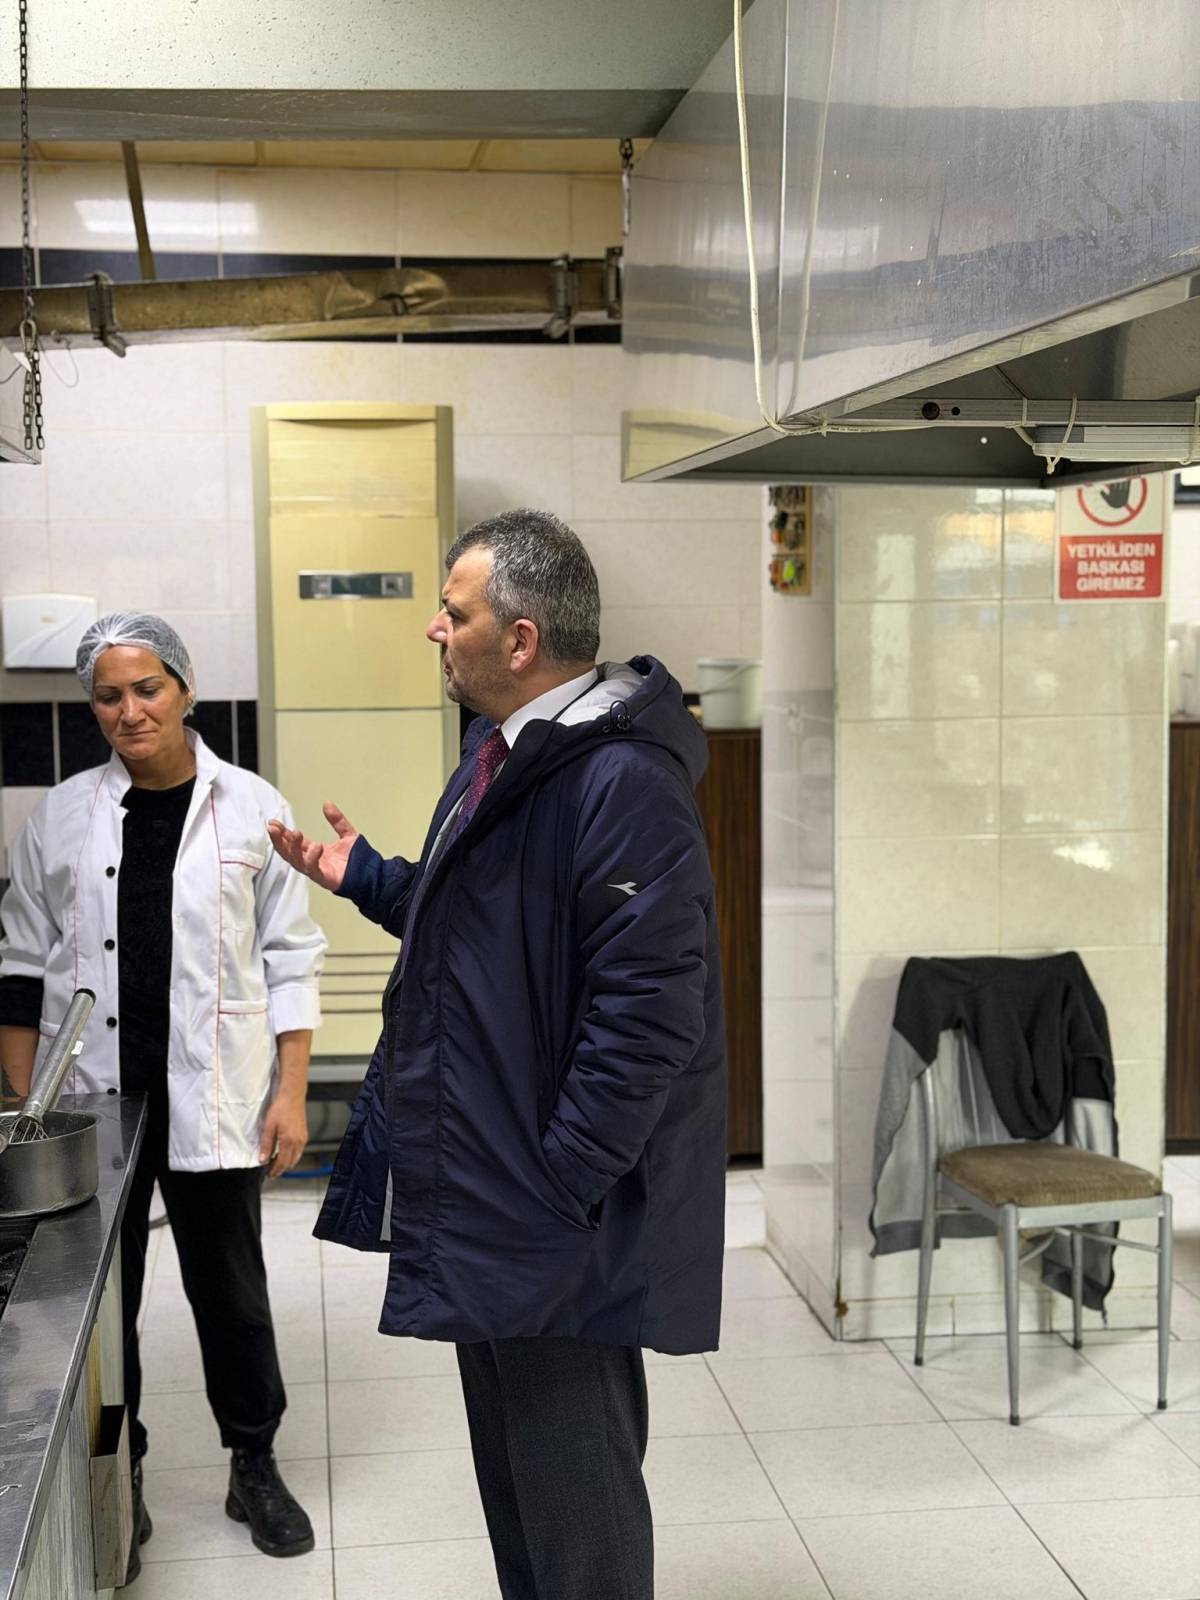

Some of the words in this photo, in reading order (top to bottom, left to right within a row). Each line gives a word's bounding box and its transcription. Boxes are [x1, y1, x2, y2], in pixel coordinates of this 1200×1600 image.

[1066, 541, 1155, 558] YETKİLİDEN
[1077, 560, 1145, 576] BAŞKASI
[1076, 576, 1145, 592] GİREMEZ
